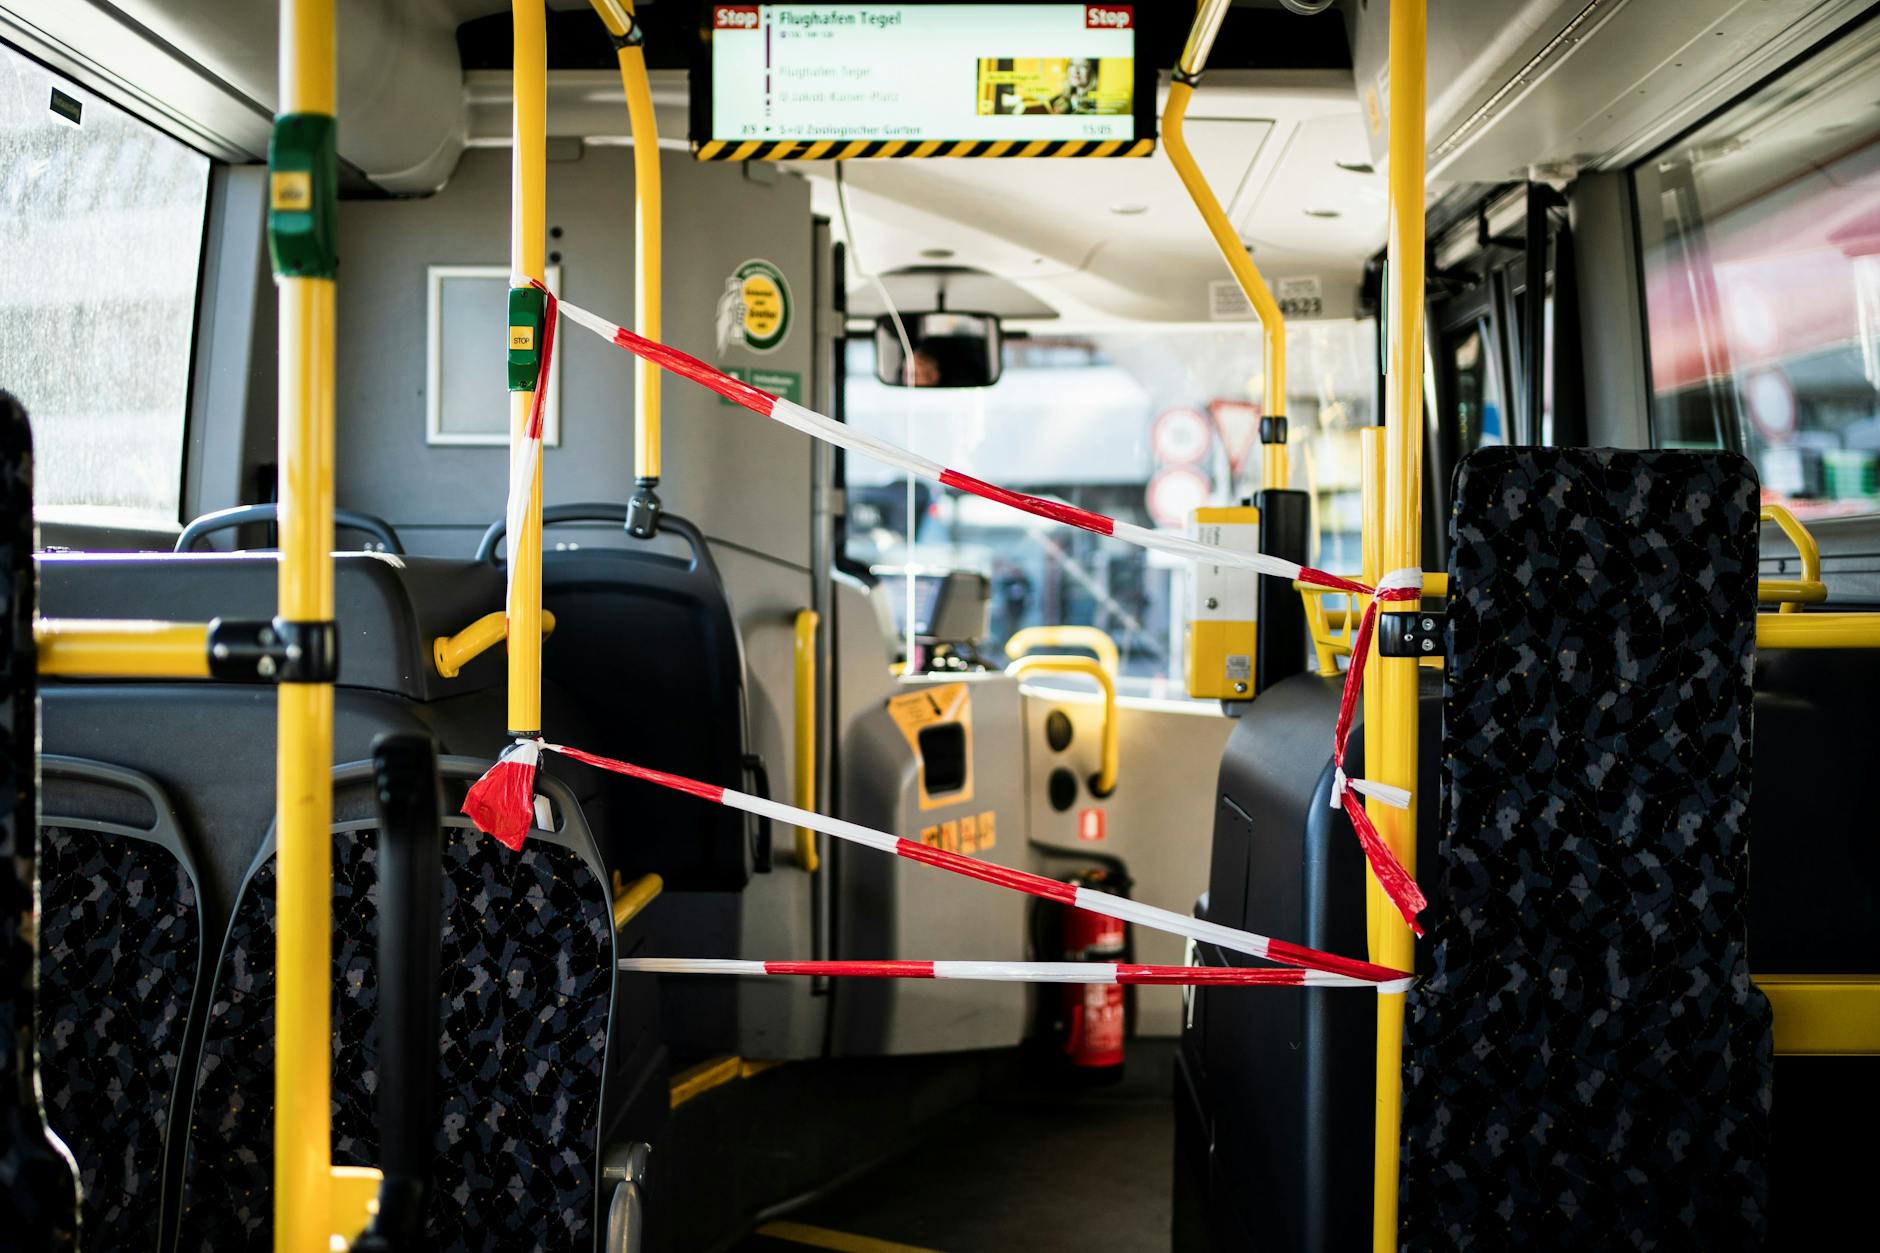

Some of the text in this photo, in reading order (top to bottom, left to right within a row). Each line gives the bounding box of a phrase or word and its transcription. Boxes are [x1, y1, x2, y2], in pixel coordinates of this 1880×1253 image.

[716, 8, 758, 29] Stop
[780, 11, 901, 28] Flughafen Tegel
[1088, 7, 1130, 28] Stop
